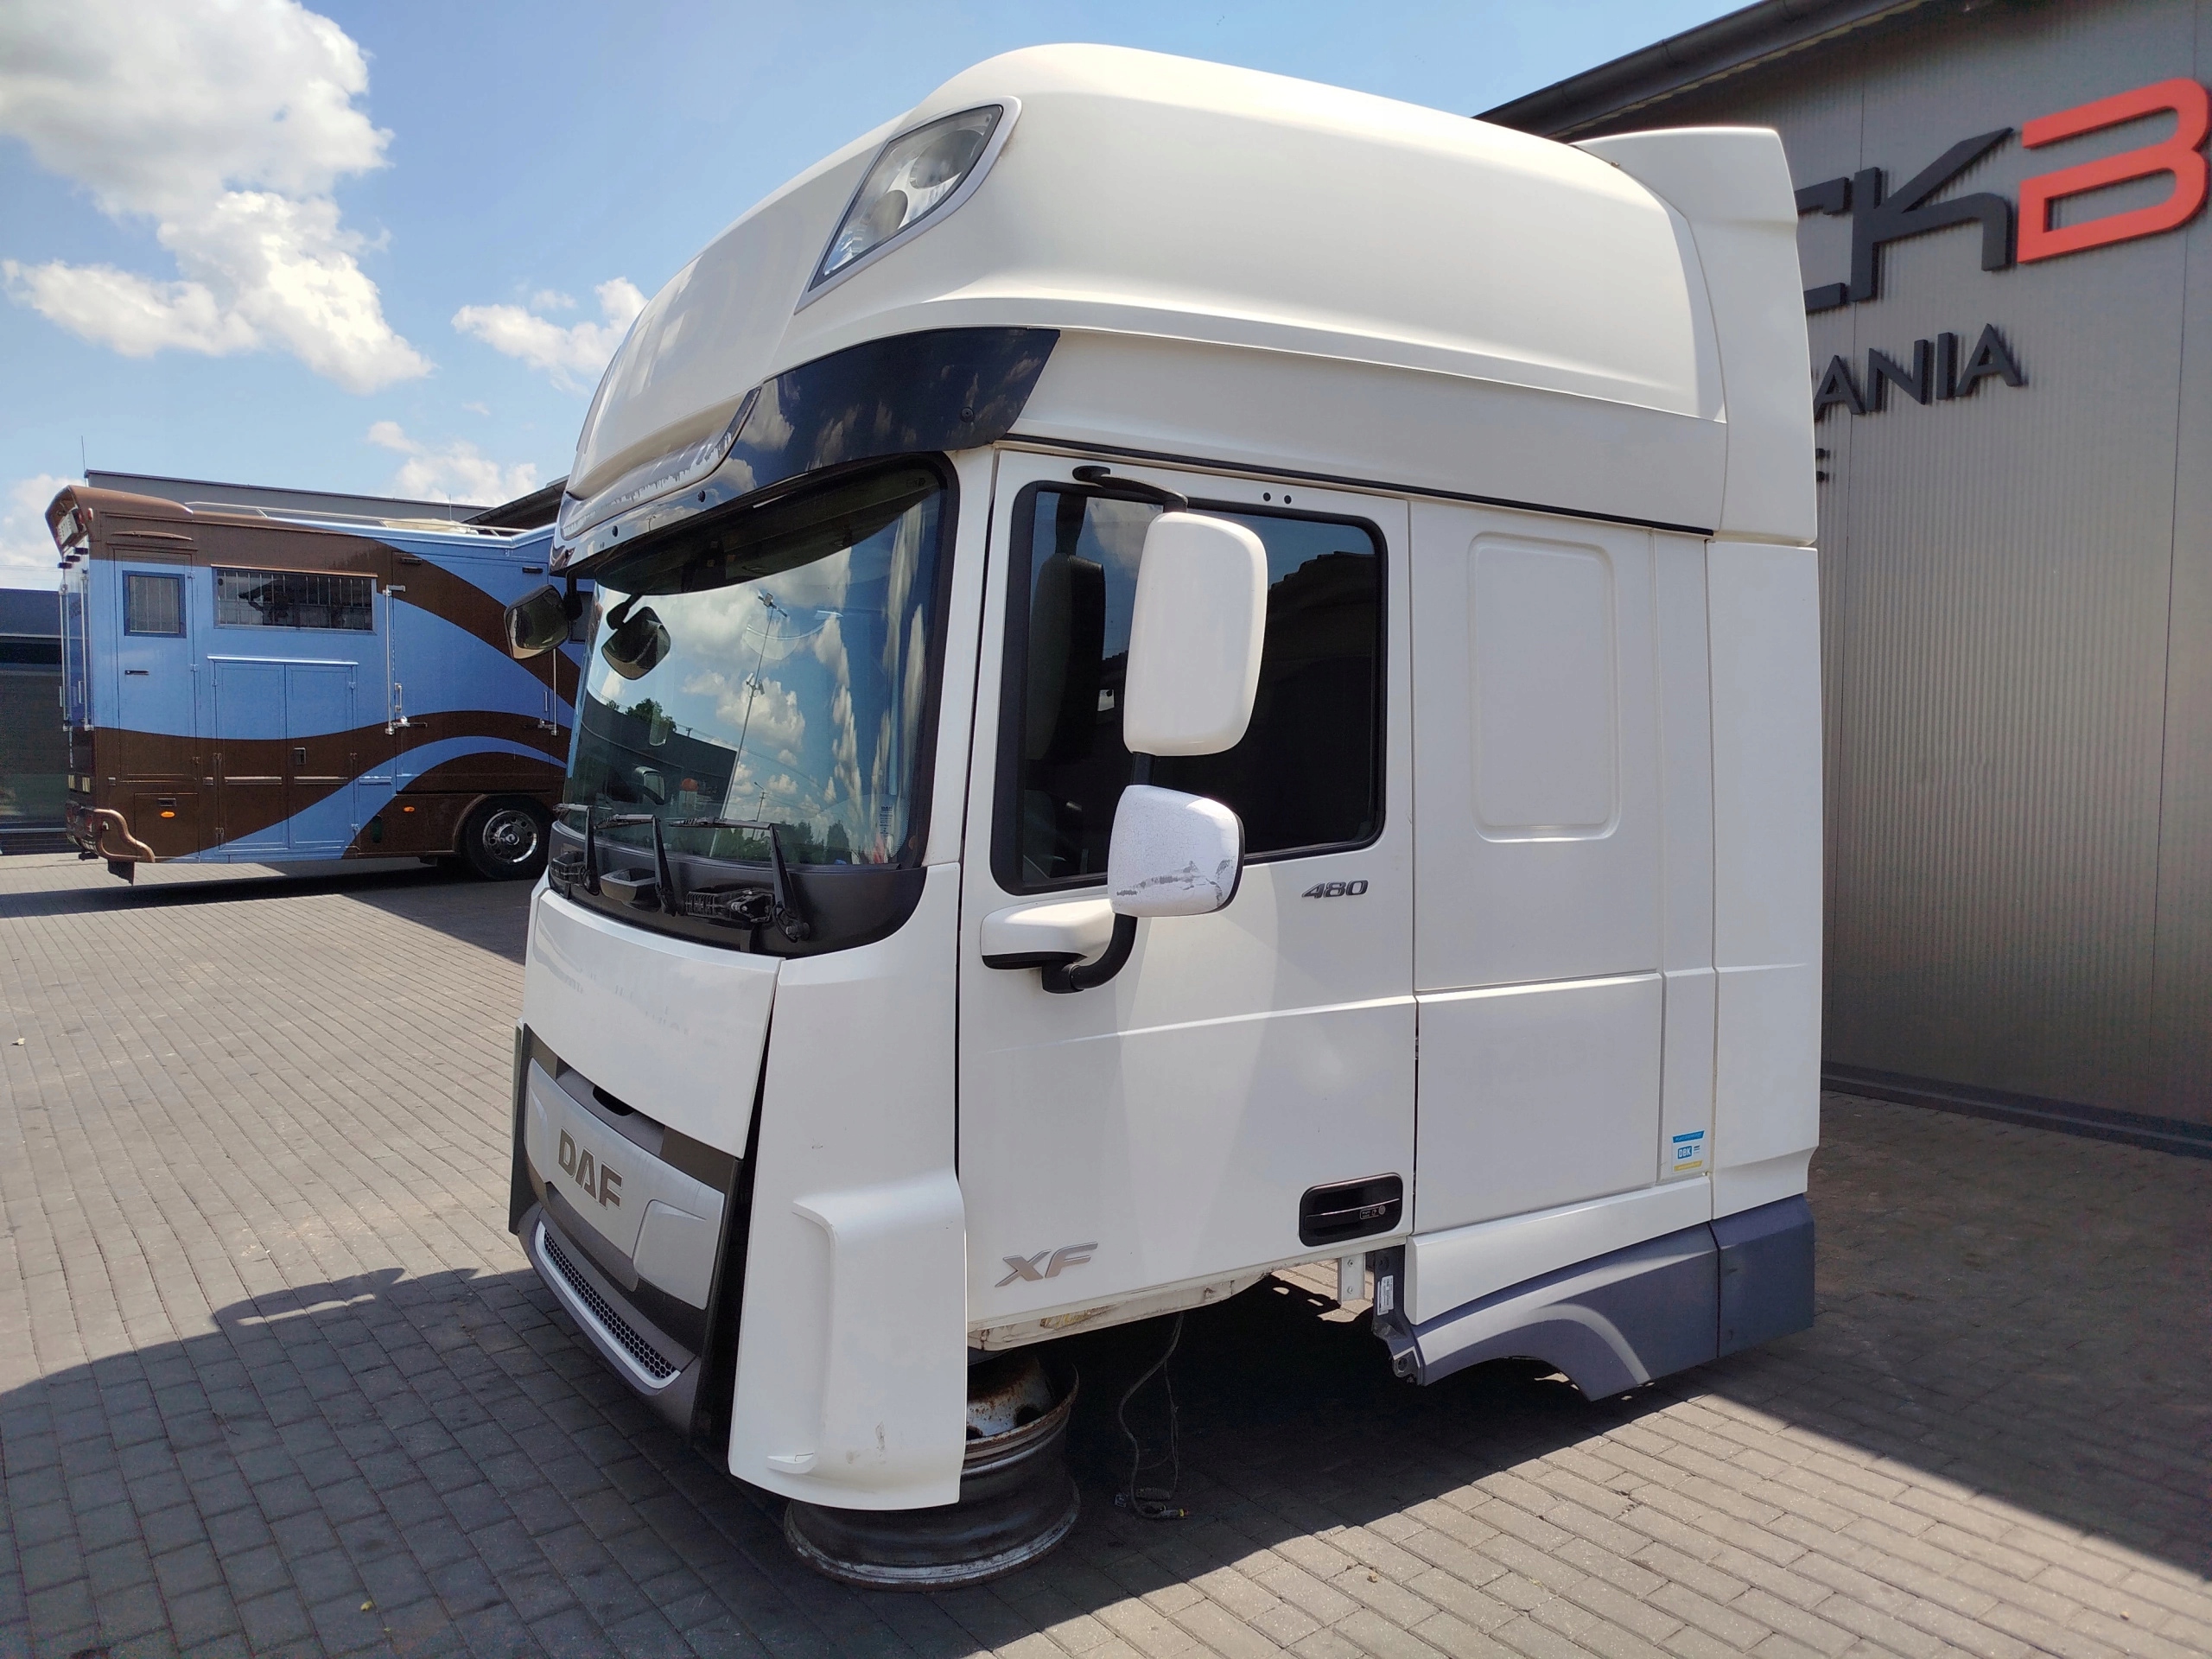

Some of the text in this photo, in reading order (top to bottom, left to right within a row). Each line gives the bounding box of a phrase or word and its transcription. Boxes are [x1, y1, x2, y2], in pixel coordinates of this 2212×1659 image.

[1301, 880, 1369, 899] 480
[558, 1127, 623, 1210] DAF
[995, 1242, 1098, 1287] XF
